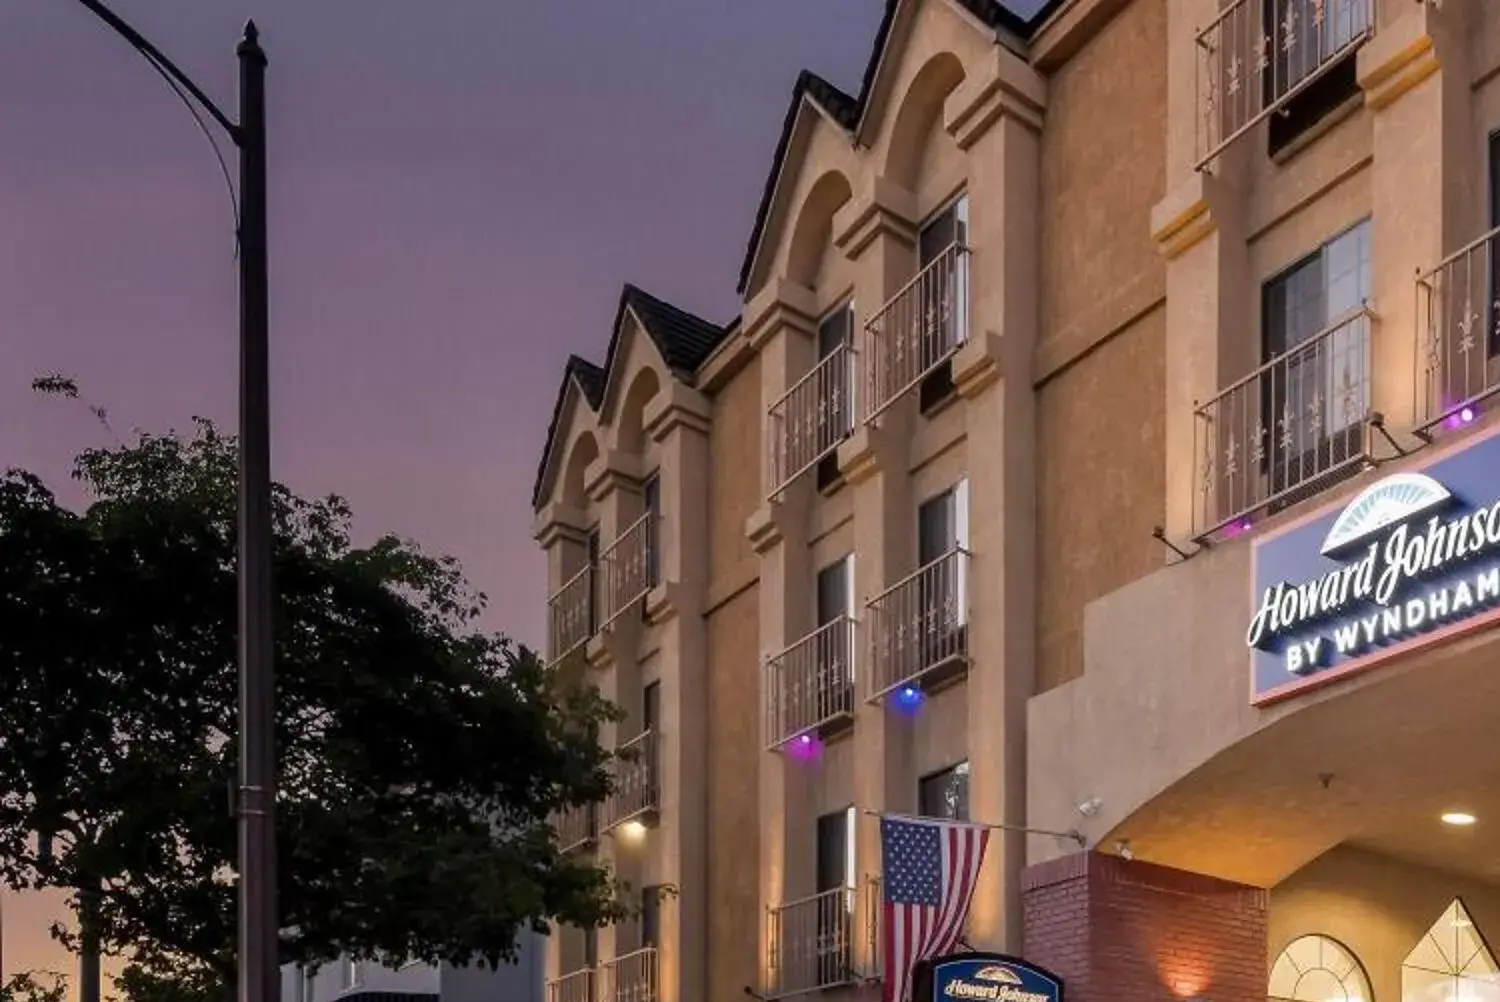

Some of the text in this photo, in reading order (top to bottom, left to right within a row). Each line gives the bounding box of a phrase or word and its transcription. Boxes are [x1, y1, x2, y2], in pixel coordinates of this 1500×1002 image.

[1247, 542, 1377, 648] Howard
[1286, 566, 1500, 672] BY WYNDHAM
